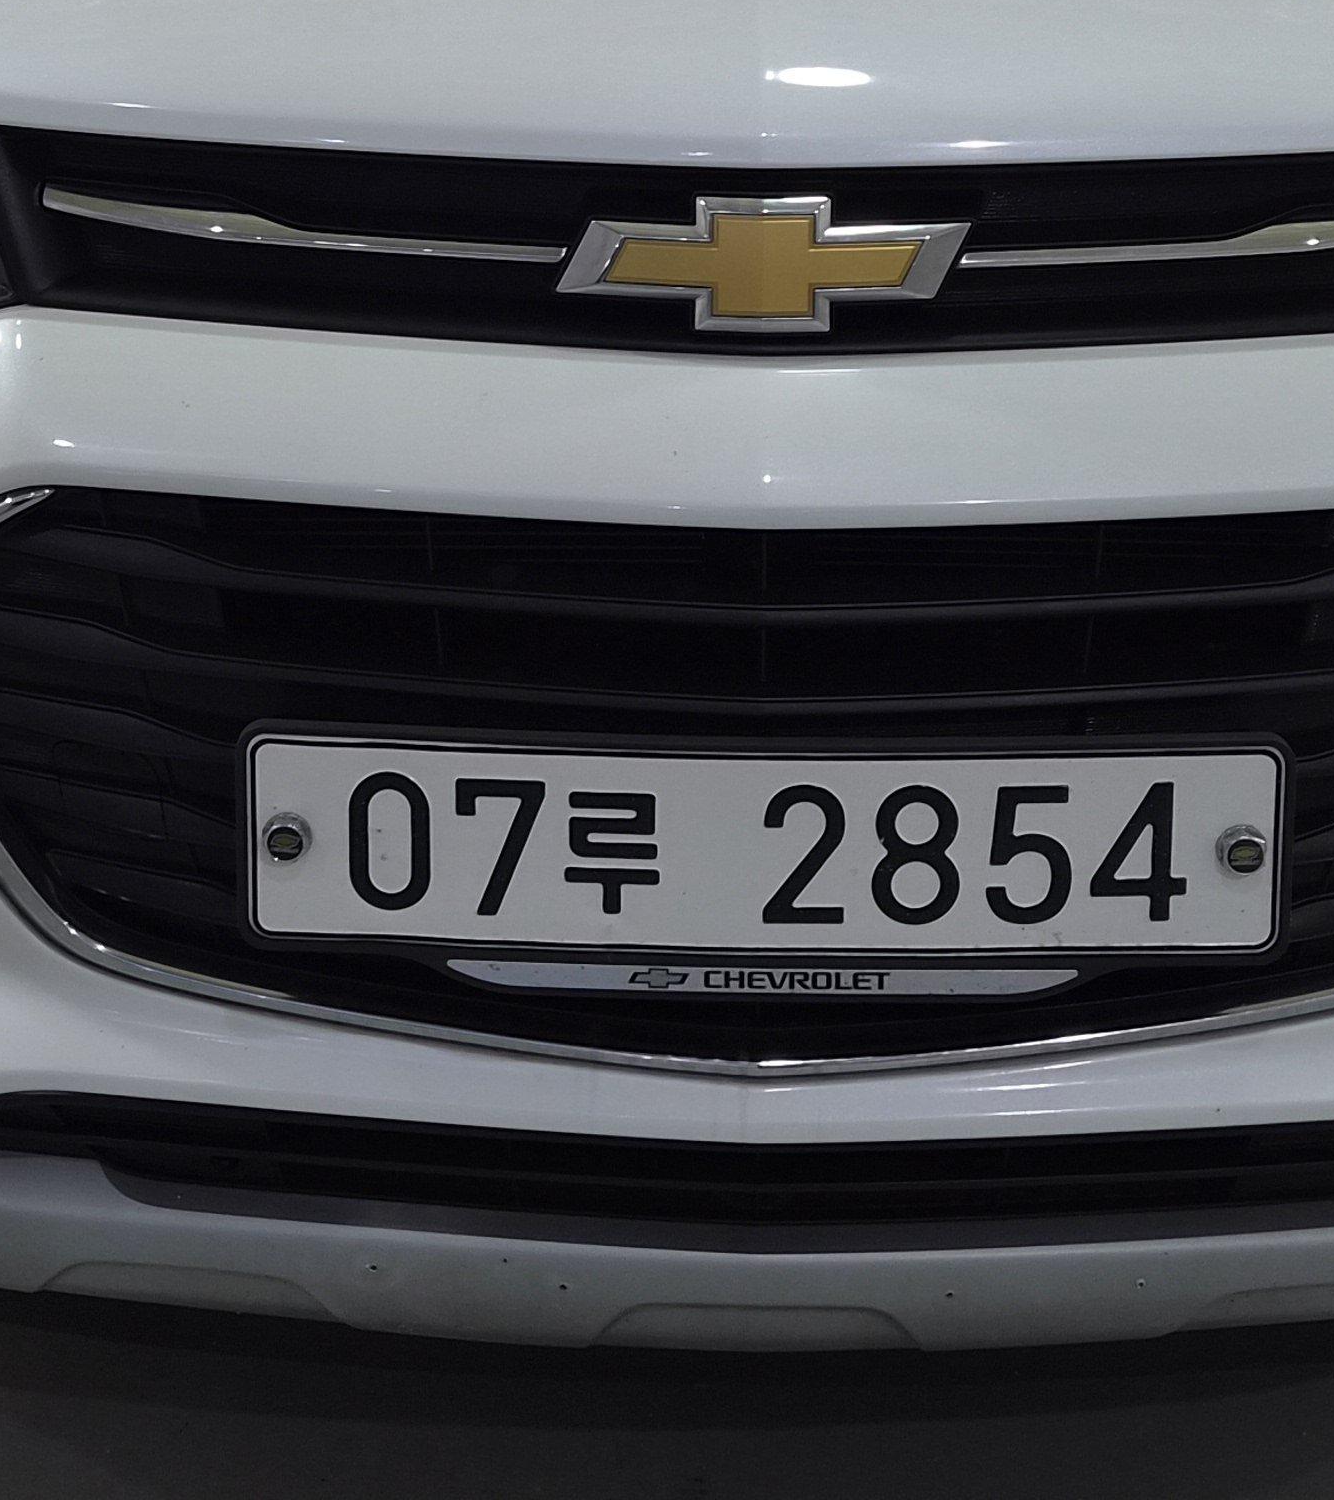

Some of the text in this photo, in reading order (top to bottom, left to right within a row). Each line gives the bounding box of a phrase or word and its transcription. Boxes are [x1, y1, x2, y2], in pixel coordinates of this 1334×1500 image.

[347, 771, 1188, 926] 07루 2854
[703, 970, 891, 991] CHEVROLET
